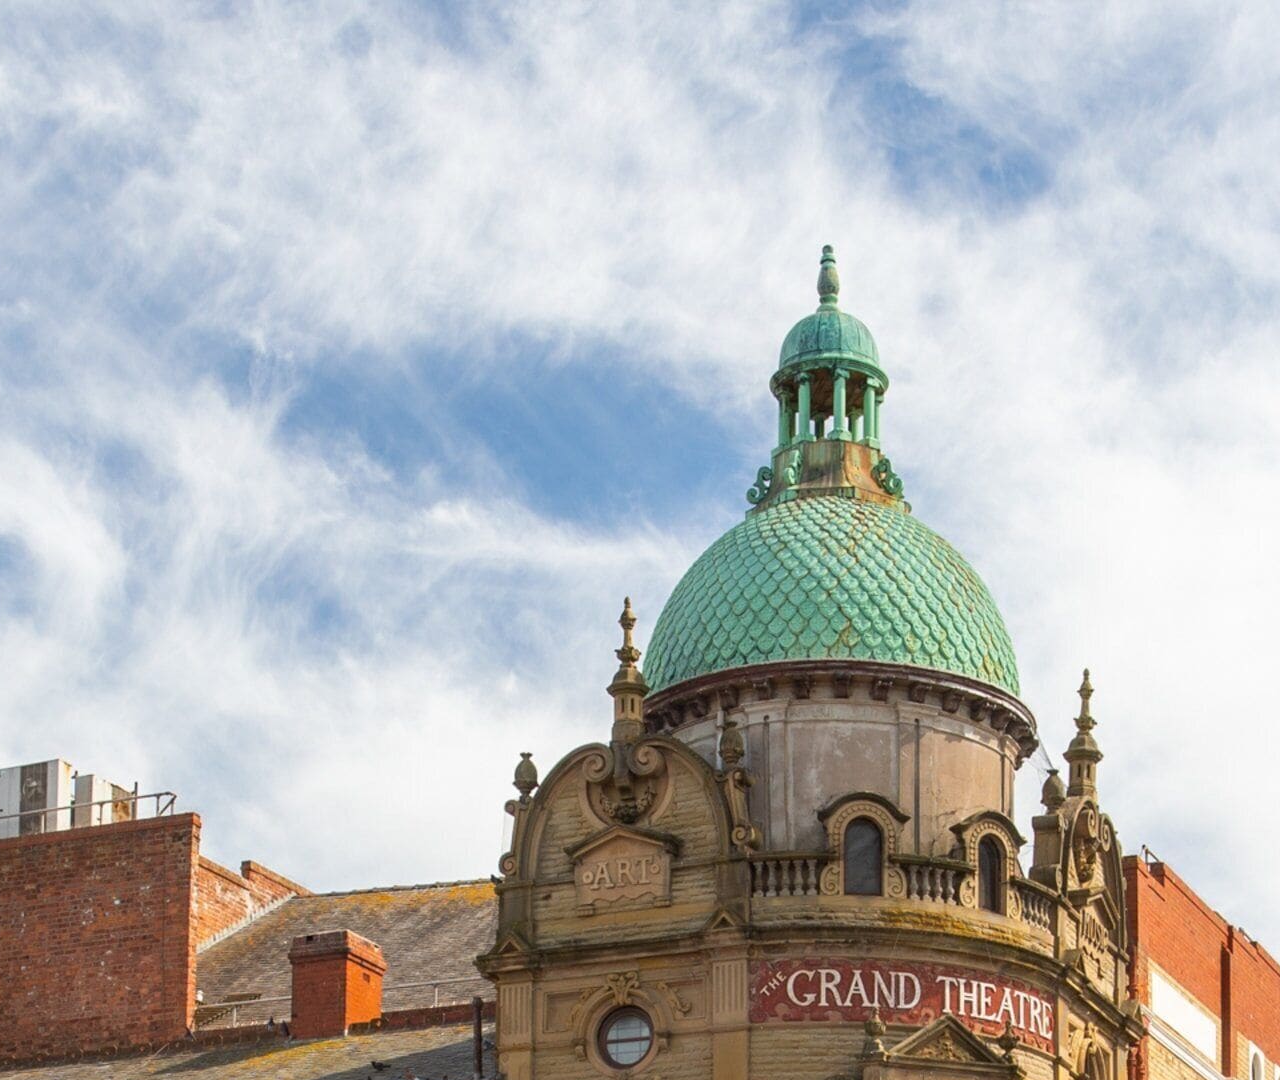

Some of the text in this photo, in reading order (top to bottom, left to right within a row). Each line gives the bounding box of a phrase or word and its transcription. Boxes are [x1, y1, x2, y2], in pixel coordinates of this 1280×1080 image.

[590, 856, 654, 890] ART
[760, 969, 1054, 1039] THE GRAND THEATRE
